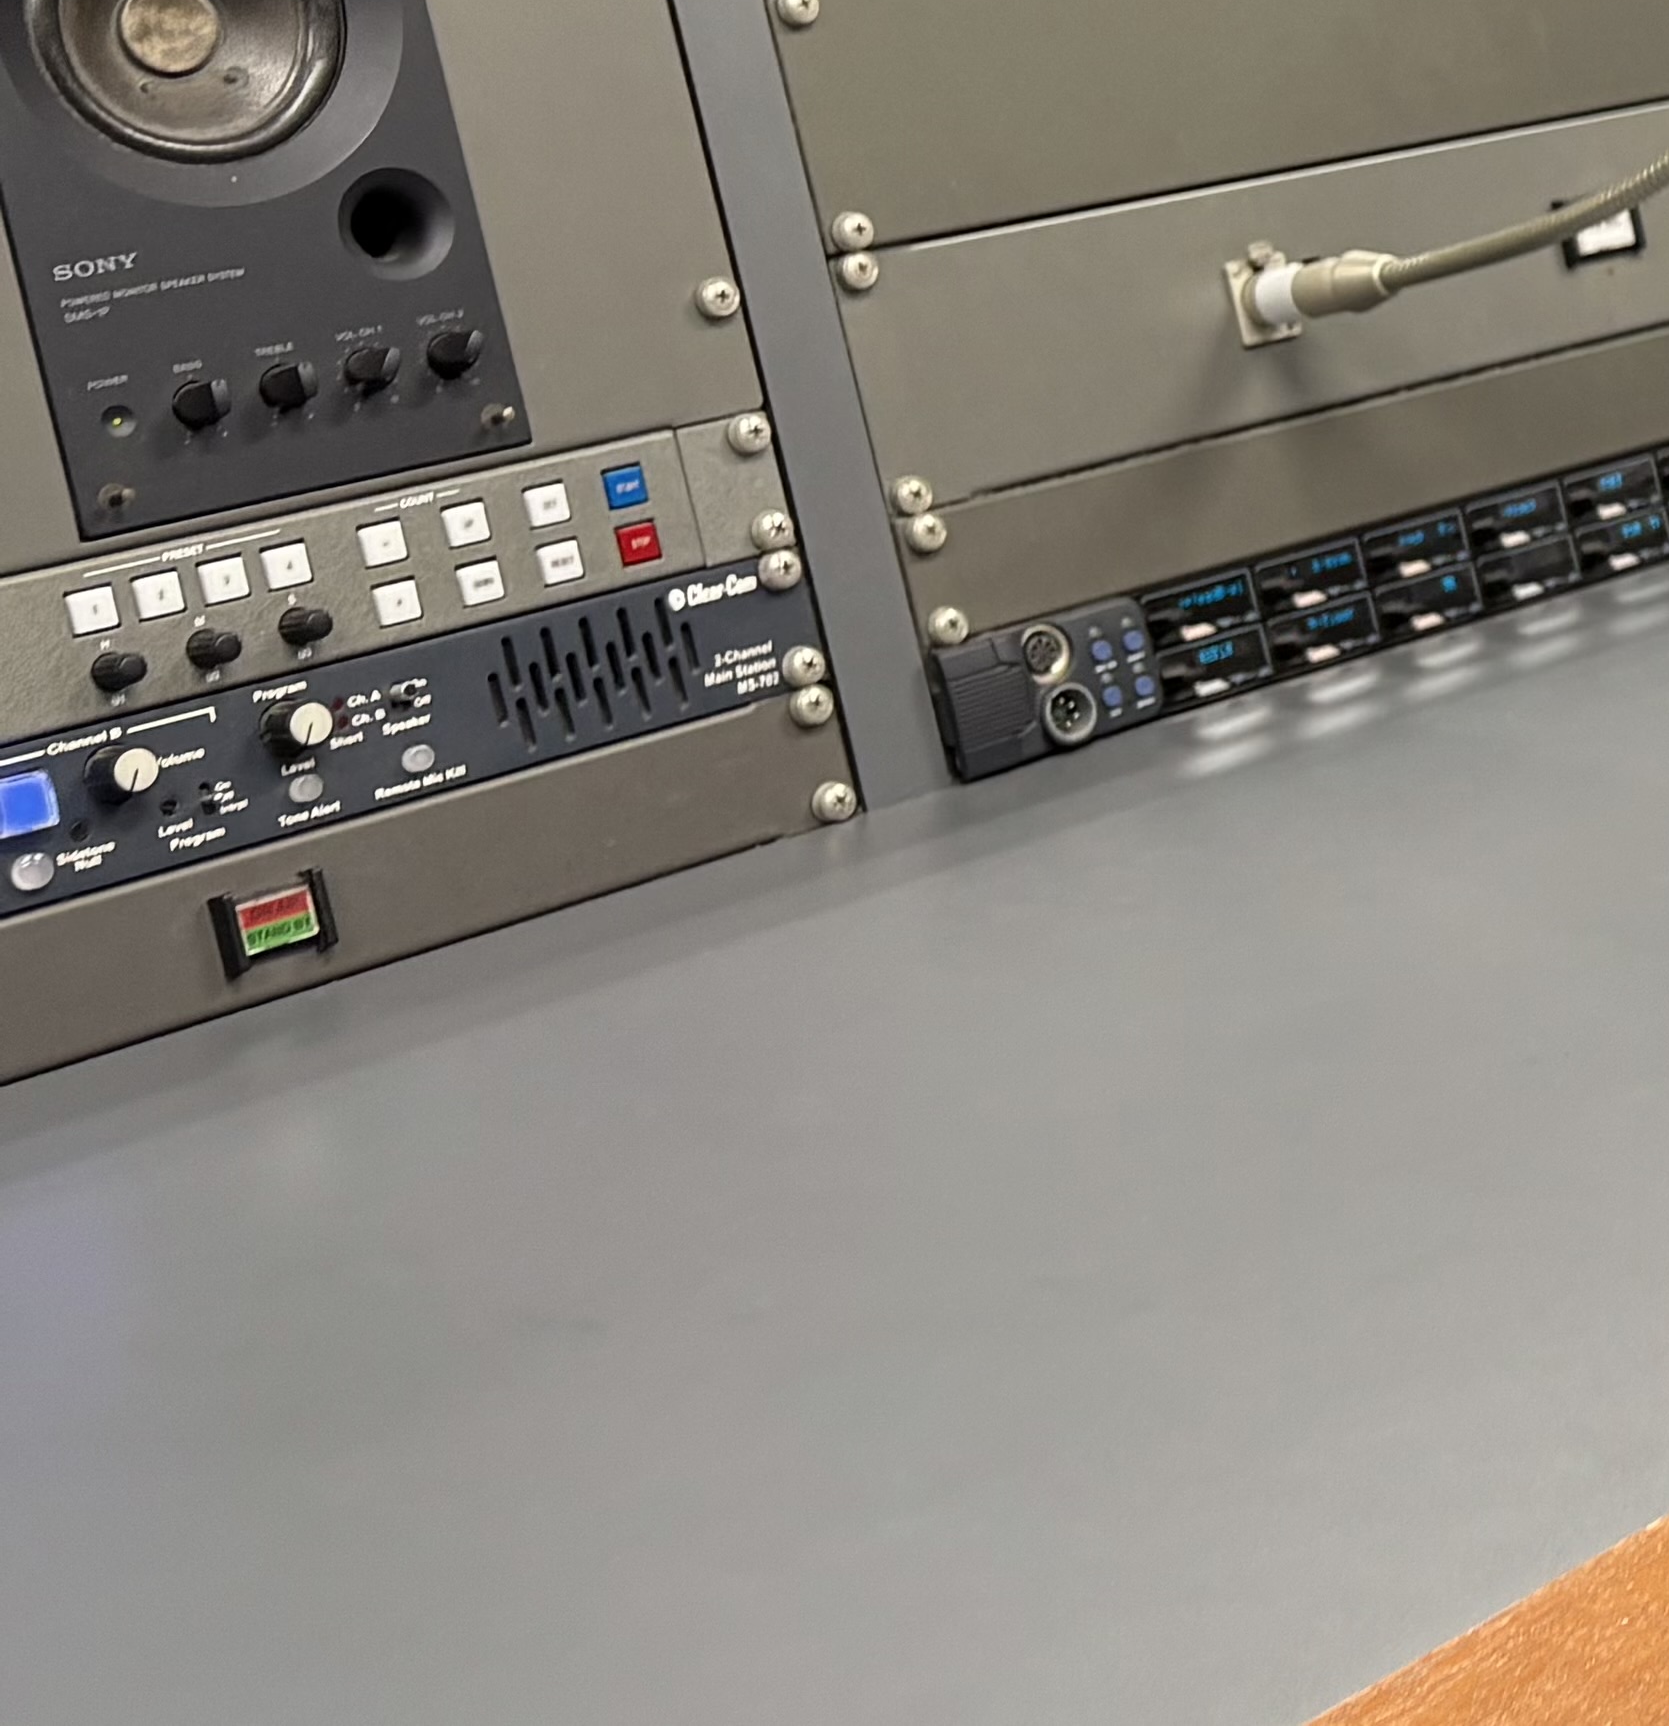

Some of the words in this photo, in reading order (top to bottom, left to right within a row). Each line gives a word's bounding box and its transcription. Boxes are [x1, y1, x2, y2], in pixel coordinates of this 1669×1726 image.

[53, 252, 137, 281] SONY
[400, 491, 434, 508] COUNT
[162, 544, 204, 562] PRESET
[687, 573, 758, 607] Clear-Com
[704, 670, 733, 687] Main
[735, 657, 777, 679] Station
[253, 680, 307, 703] Program
[382, 714, 431, 736] Speaker
[47, 730, 107, 756] Channel
[281, 757, 316, 776] Level
[310, 800, 342, 819] Alert
[158, 818, 194, 838] Level
[170, 827, 226, 851] Program
[56, 841, 116, 867] Sidetone
